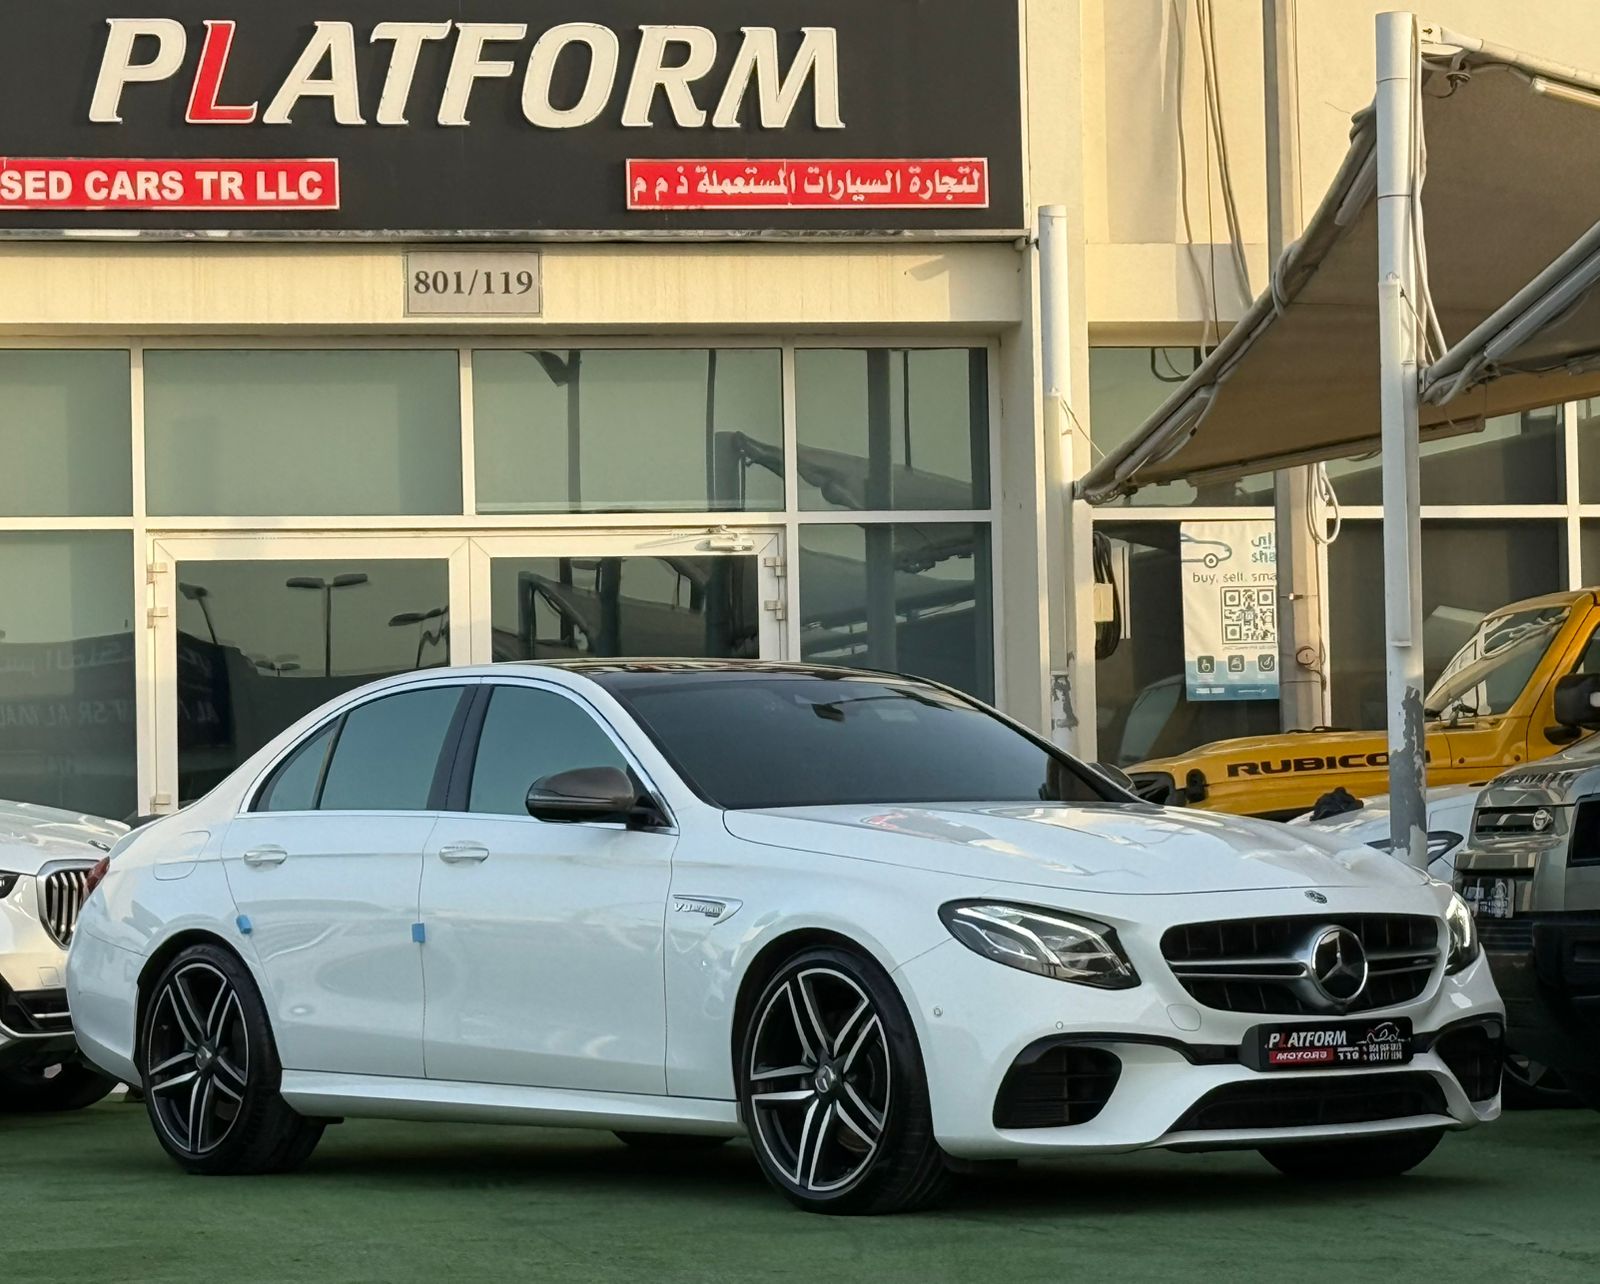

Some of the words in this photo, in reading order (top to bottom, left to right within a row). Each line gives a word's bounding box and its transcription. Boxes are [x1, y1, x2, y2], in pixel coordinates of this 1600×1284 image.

[89, 17, 846, 129] PLATFORM
[0, 170, 73, 201] SED
[84, 170, 185, 201] CARS
[195, 170, 245, 201] TR
[256, 170, 324, 200] LLC
[633, 176, 648, 203] م
[655, 176, 669, 203] م
[676, 165, 689, 195] ذ
[695, 165, 796, 196] المستعملة
[803, 166, 902, 202] السيارات
[908, 166, 981, 200] لتجارة
[413, 269, 534, 296] 801/119
[1193, 572, 1218, 585] buy.
[1227, 750, 1431, 777] RUBICO
[1269, 1030, 1347, 1048] PLATFORM
